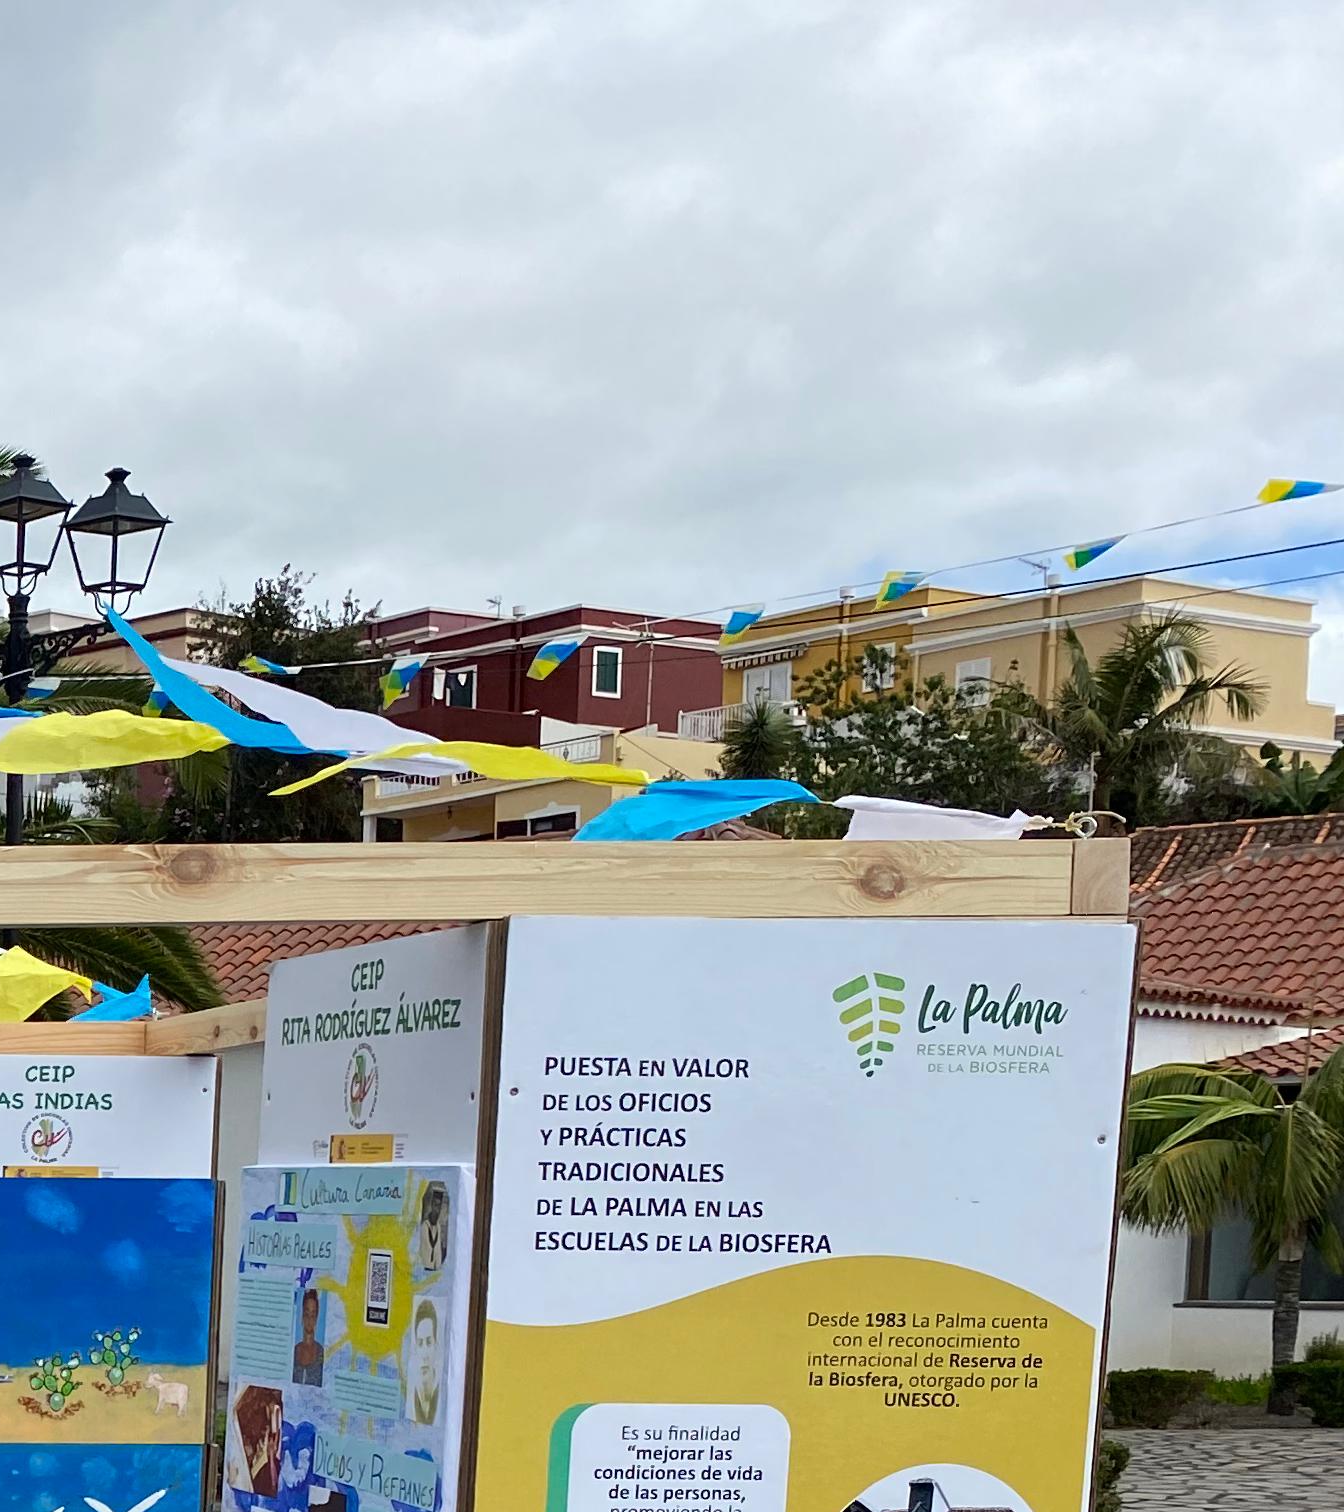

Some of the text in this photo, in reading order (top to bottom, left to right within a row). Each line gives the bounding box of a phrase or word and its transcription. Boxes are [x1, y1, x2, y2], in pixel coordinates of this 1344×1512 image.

[351, 958, 385, 993] CEIP
[918, 983, 1068, 1034] La Palma
[282, 992, 462, 1047] RITA RODRÍGUEZ ÁLVAREZ
[917, 1044, 1063, 1057] RESERVA MUNDIAL
[26, 1066, 75, 1083] CEIP
[545, 1057, 748, 1078] PUESTA EN VALOR
[928, 1061, 1049, 1073] DE LA BIOSFERA
[35, 1093, 112, 1110] INDIAS
[543, 1093, 711, 1112] DE LOS OFICIOS
[541, 1122, 686, 1147] Y PRÁCTICAS
[539, 1162, 723, 1182] TRADICIONALES
[537, 1197, 763, 1218] DE LA PALMA EN LAS
[536, 1232, 831, 1253] ESCUELAS DE LA BIOSFERA
[808, 1312, 1047, 1329] Desde 1983 La Palma cuenta
[833, 1332, 1021, 1348] con el reconocimiento
[808, 1351, 1044, 1369] internacional de Reserva de
[809, 1371, 1037, 1392] la Biosfera, otorgado por la
[884, 1391, 960, 1408] UNESCO.
